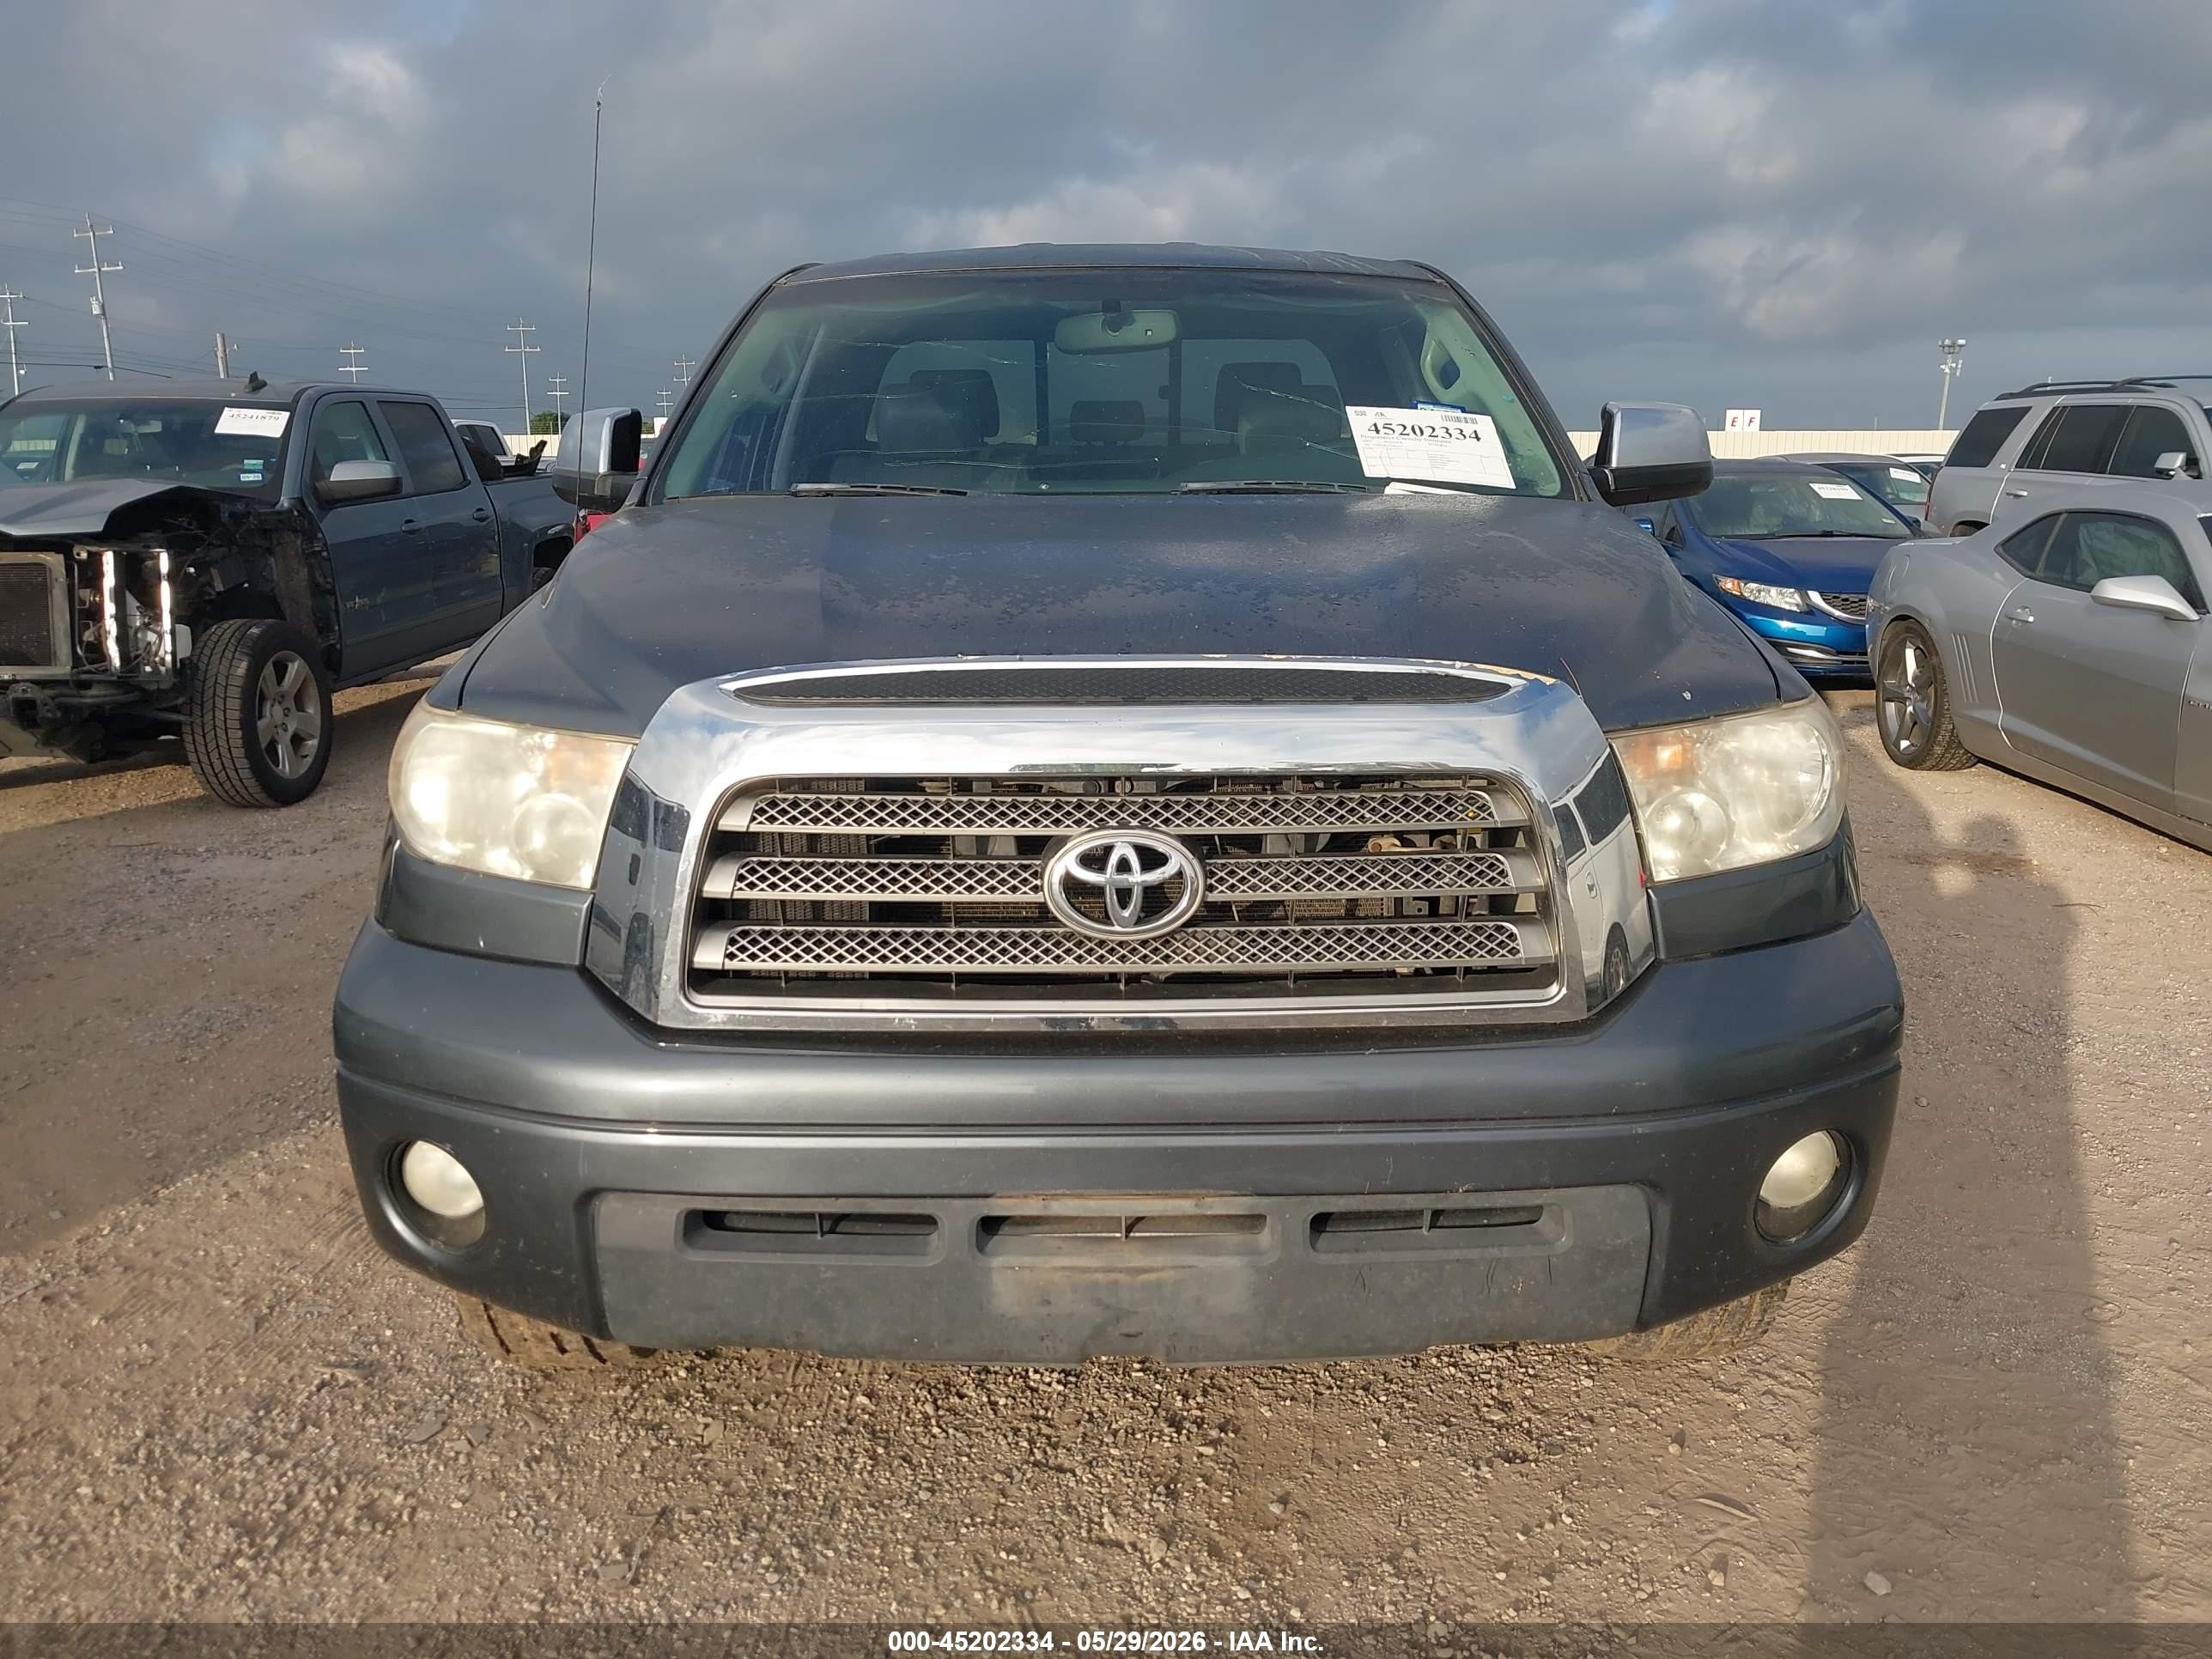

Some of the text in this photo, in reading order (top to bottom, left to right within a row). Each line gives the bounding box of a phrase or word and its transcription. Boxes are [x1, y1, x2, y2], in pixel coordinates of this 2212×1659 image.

[1730, 416, 1756, 427] E F
[1367, 422, 1482, 442] 45202334
